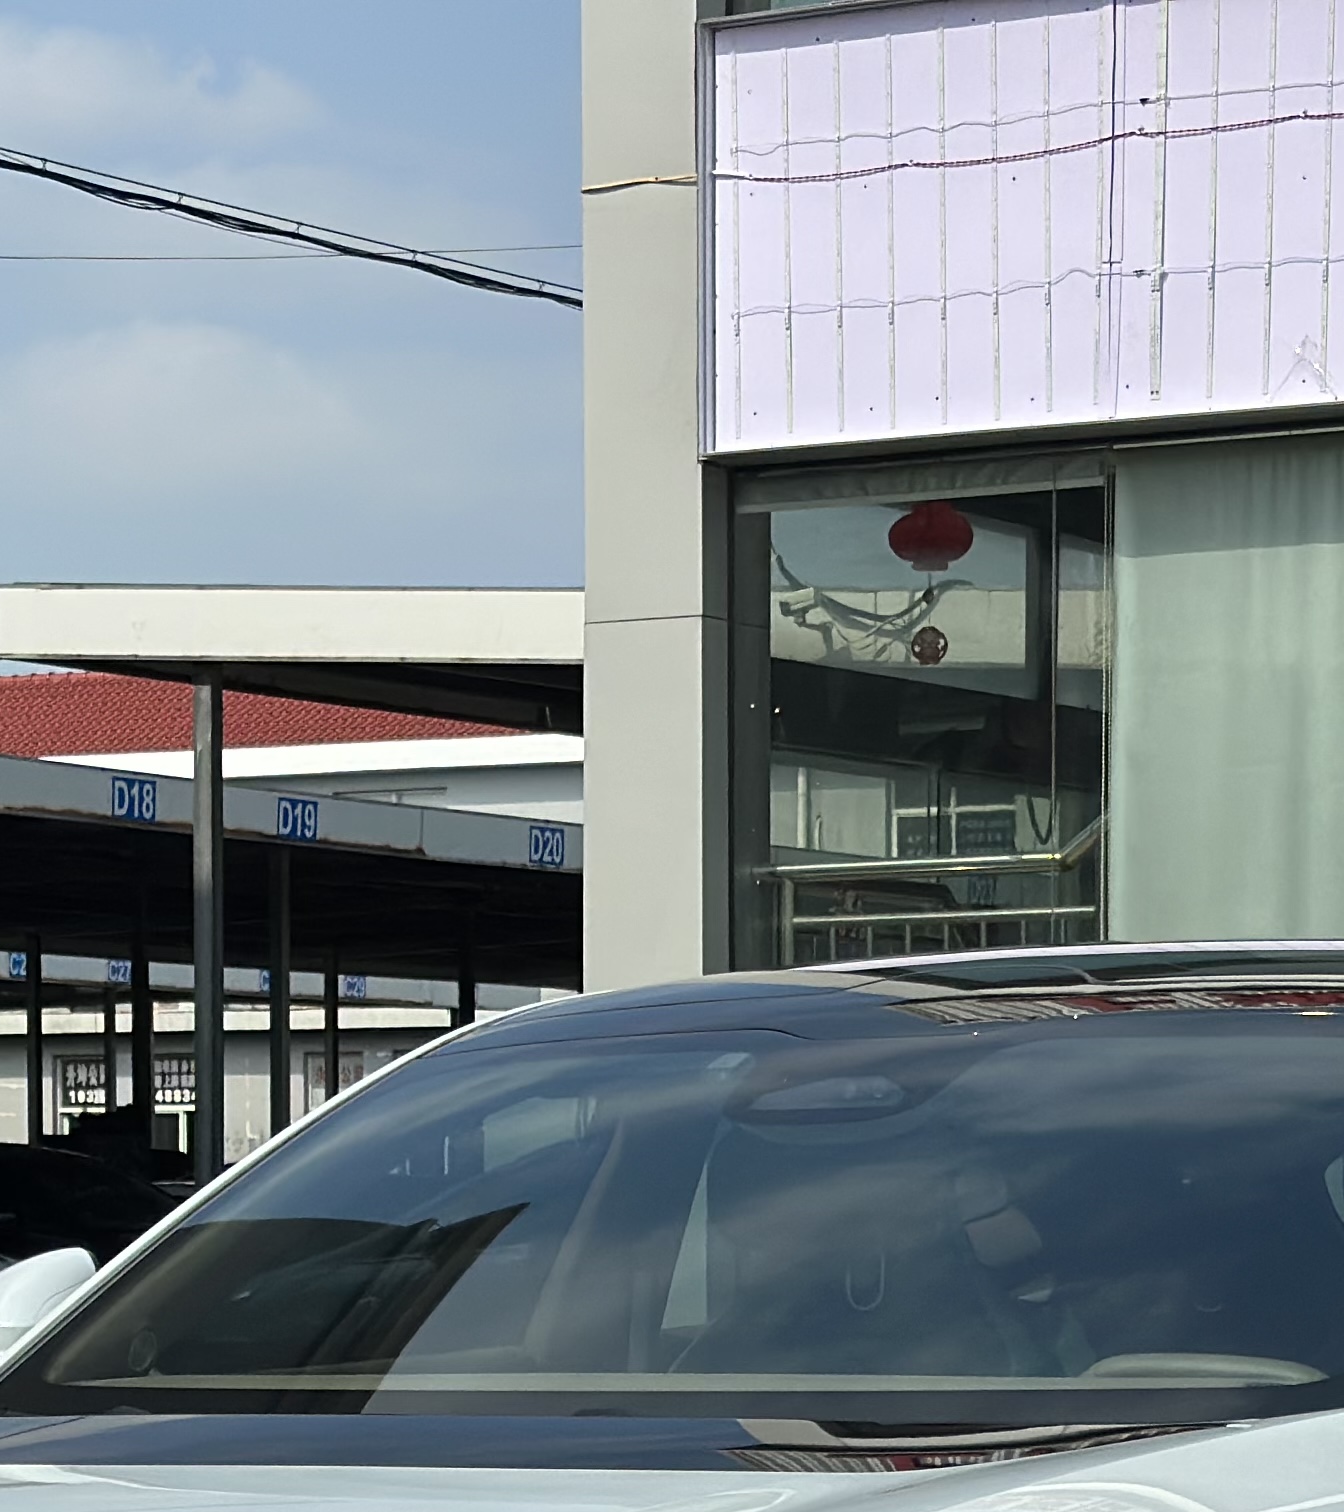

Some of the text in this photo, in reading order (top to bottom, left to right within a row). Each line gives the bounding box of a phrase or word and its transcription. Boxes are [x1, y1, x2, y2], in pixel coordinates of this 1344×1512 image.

[114, 778, 154, 820] D18
[278, 799, 316, 839] D19
[530, 827, 563, 864] D20
[10, 952, 27, 975] C2
